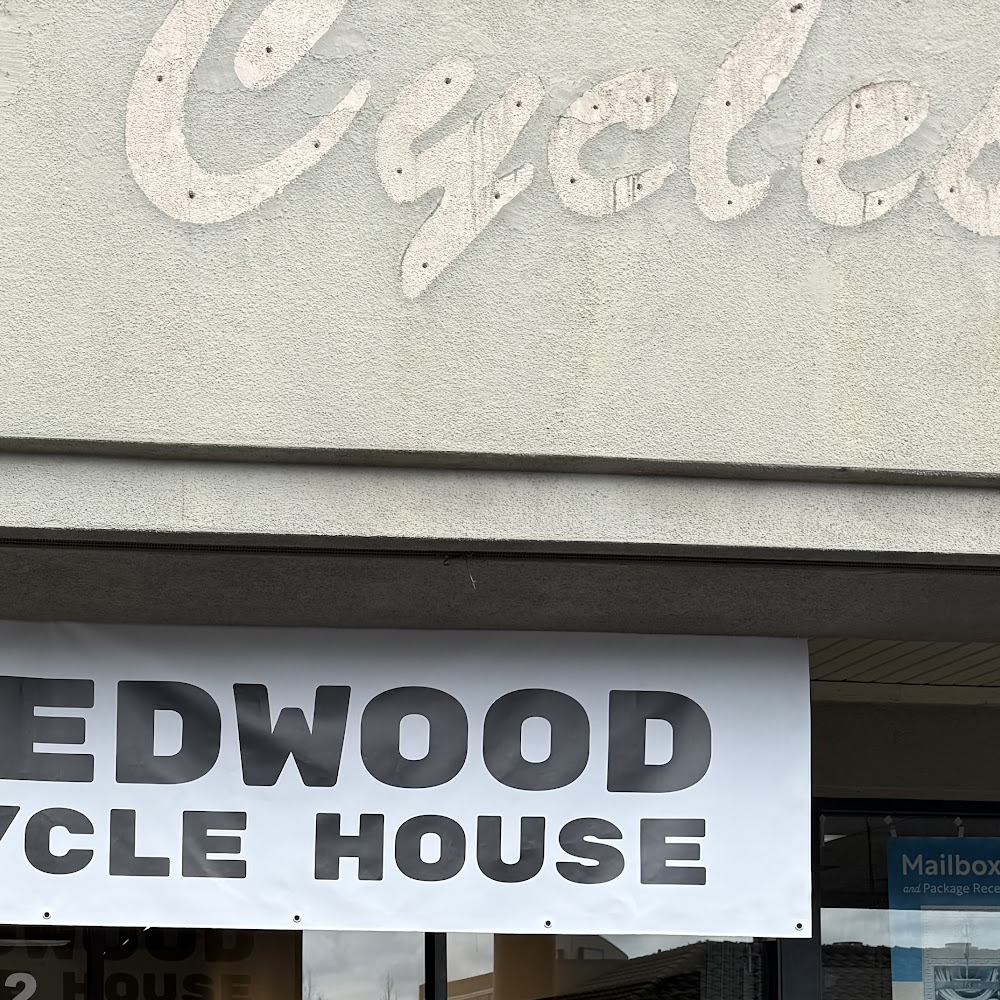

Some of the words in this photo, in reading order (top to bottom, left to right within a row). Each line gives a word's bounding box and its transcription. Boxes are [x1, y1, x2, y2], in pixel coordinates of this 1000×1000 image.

[314, 812, 707, 886] HOUSE
[903, 883, 921, 893] and
[923, 883, 970, 896] Package
